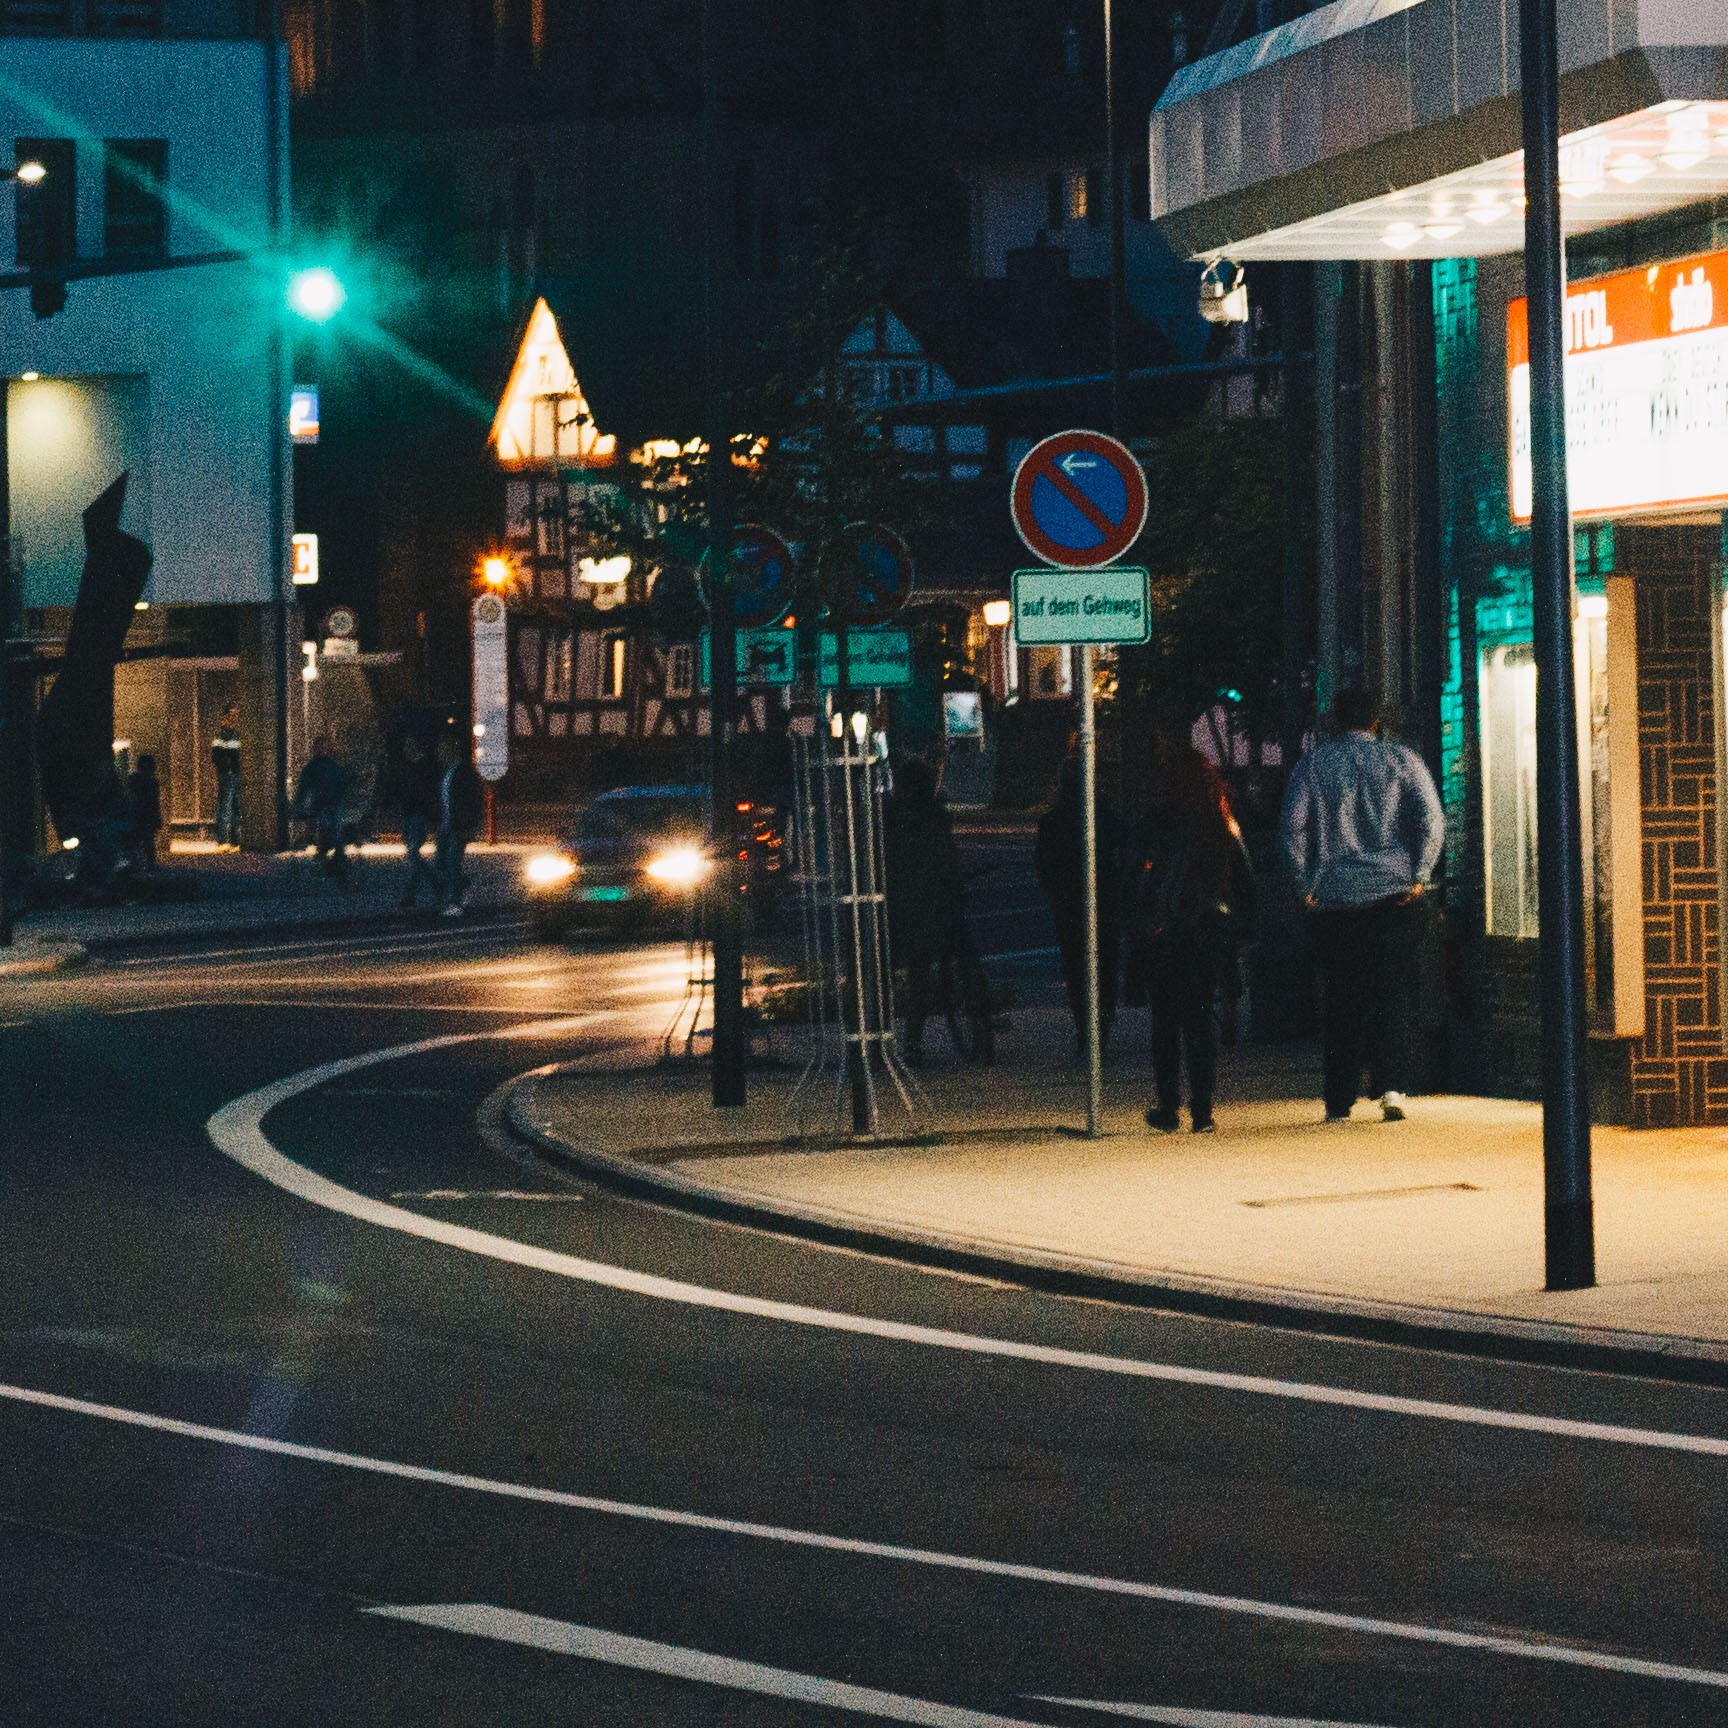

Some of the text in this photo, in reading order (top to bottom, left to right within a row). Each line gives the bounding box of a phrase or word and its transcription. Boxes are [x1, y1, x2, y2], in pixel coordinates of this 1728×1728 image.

[1022, 594, 1141, 620] auf dem Gehweg
